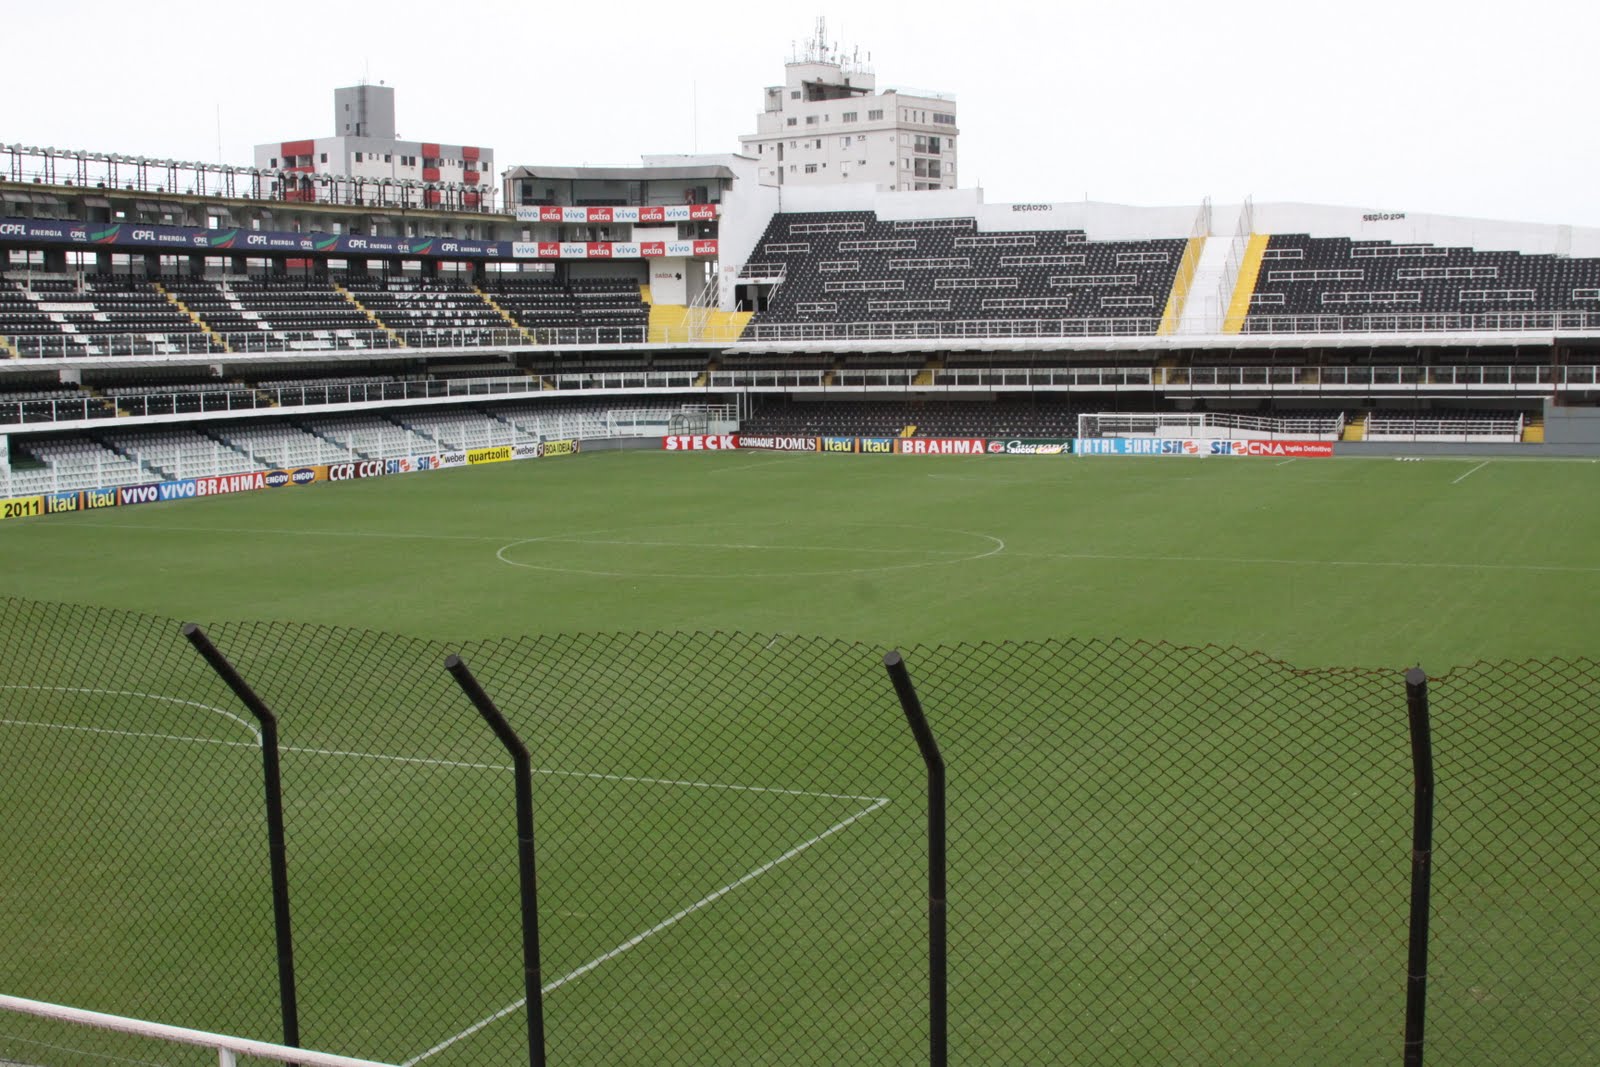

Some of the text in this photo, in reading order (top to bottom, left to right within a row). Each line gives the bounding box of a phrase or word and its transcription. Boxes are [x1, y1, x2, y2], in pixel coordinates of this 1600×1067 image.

[518, 209, 538, 218] vivo
[541, 209, 561, 220] extra
[564, 210, 585, 219] vivo
[589, 209, 610, 220] extra
[615, 210, 637, 219] vivo
[641, 208, 662, 220] extra
[666, 208, 688, 217] vivo
[692, 206, 713, 218] extra
[0, 223, 63, 237] CPFL ENERGIA
[132, 230, 187, 242] CPFL ENERGIA
[247, 235, 268, 245] CPFL
[348, 239, 368, 249] CPFL
[441, 243, 459, 252] CPFL
[515, 244, 536, 254] vivo
[540, 245, 558, 255] extra
[563, 245, 584, 254] vivo
[589, 245, 610, 256] extra
[615, 244, 637, 254] vivo
[642, 244, 663, 255] extra
[668, 243, 690, 252] vivo
[695, 242, 716, 253] extra
[665, 436, 737, 450] STECK
[738, 437, 816, 451] CONHAQUE DOMUS
[824, 437, 852, 452] Itaú
[863, 438, 891, 453] Itaú
[902, 440, 984, 454] BRAHMA
[1125, 439, 1159, 453] SURF
[1162, 440, 1183, 454] Sil
[1211, 441, 1232, 455] Sil
[1248, 442, 1286, 455] CNA
[468, 448, 510, 465] quartzolit
[516, 446, 535, 455] weber
[417, 457, 430, 470] Sil
[444, 454, 466, 463] weber
[329, 460, 384, 481] CCR CCR
[387, 460, 400, 474] Sil
[265, 475, 289, 484] ENGOV
[292, 471, 315, 481] ENGOV
[161, 482, 195, 499] VIVO
[197, 475, 264, 496] BRAHMA
[87, 489, 115, 508] Itaú
[121, 486, 158, 503] VIVO
[48, 493, 77, 513] Itaú
[4, 501, 40, 518] 2011
